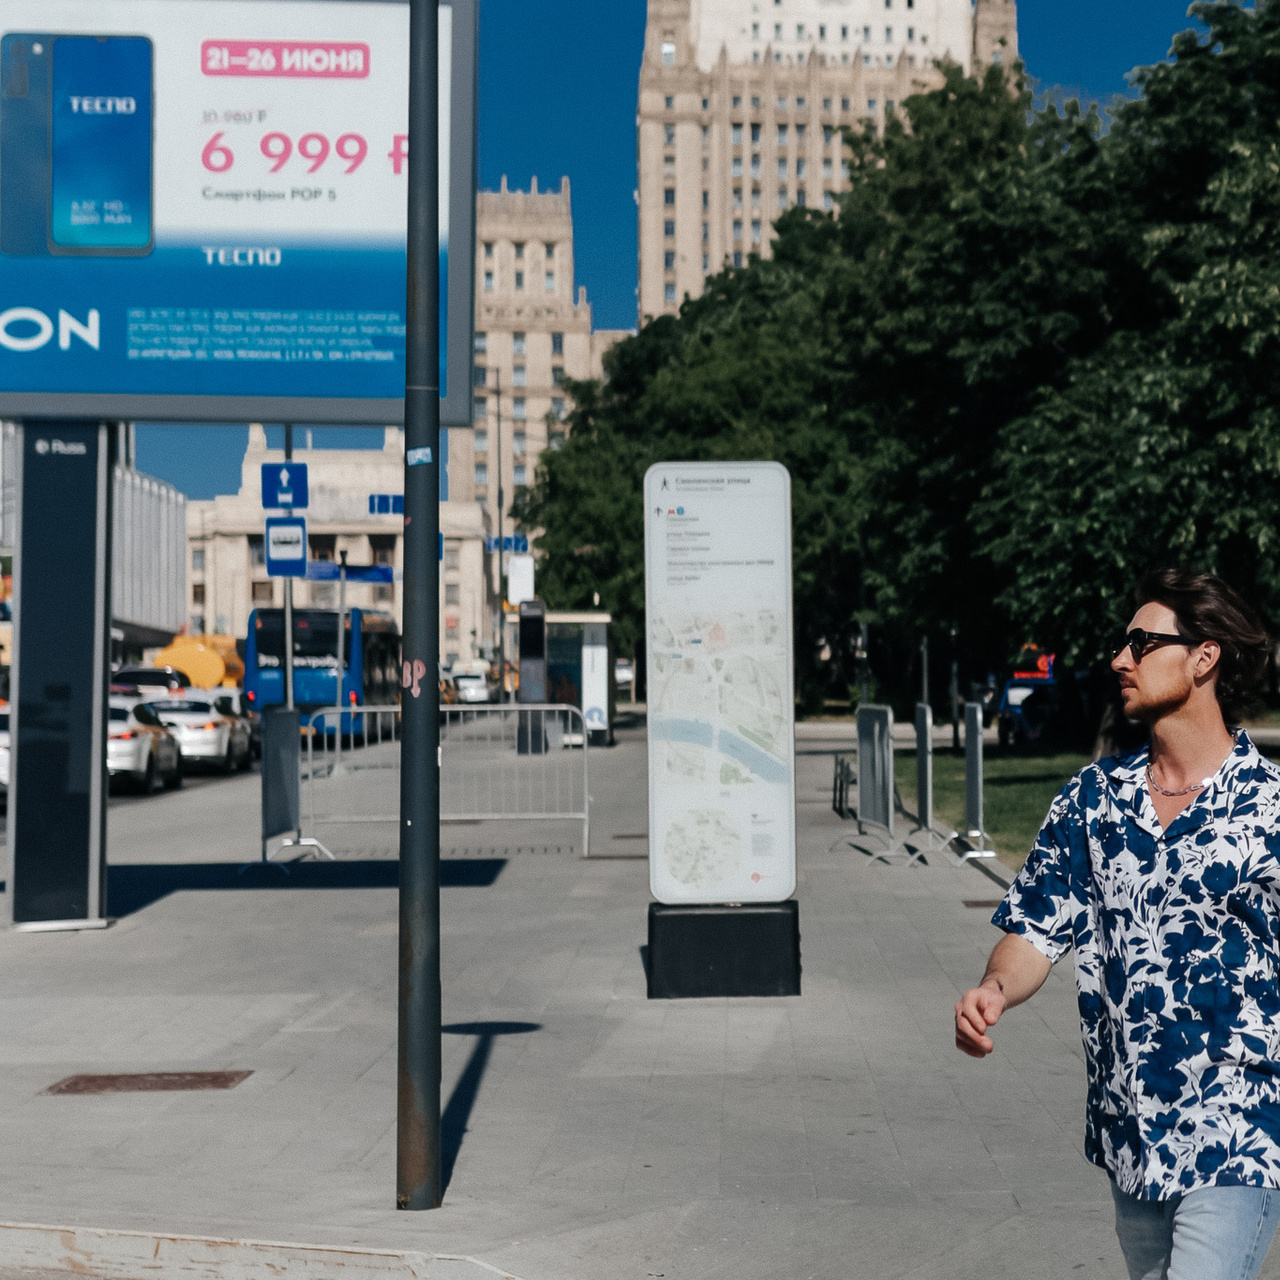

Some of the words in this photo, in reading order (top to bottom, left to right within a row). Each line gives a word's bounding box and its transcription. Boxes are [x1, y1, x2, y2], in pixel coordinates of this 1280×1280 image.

[282, 48, 364, 73] ИЮНЯ
[70, 96, 136, 114] TECNO
[201, 131, 234, 173] 6
[259, 131, 368, 174] 999
[203, 247, 281, 265] TECNO
[0, 306, 100, 351] ON
